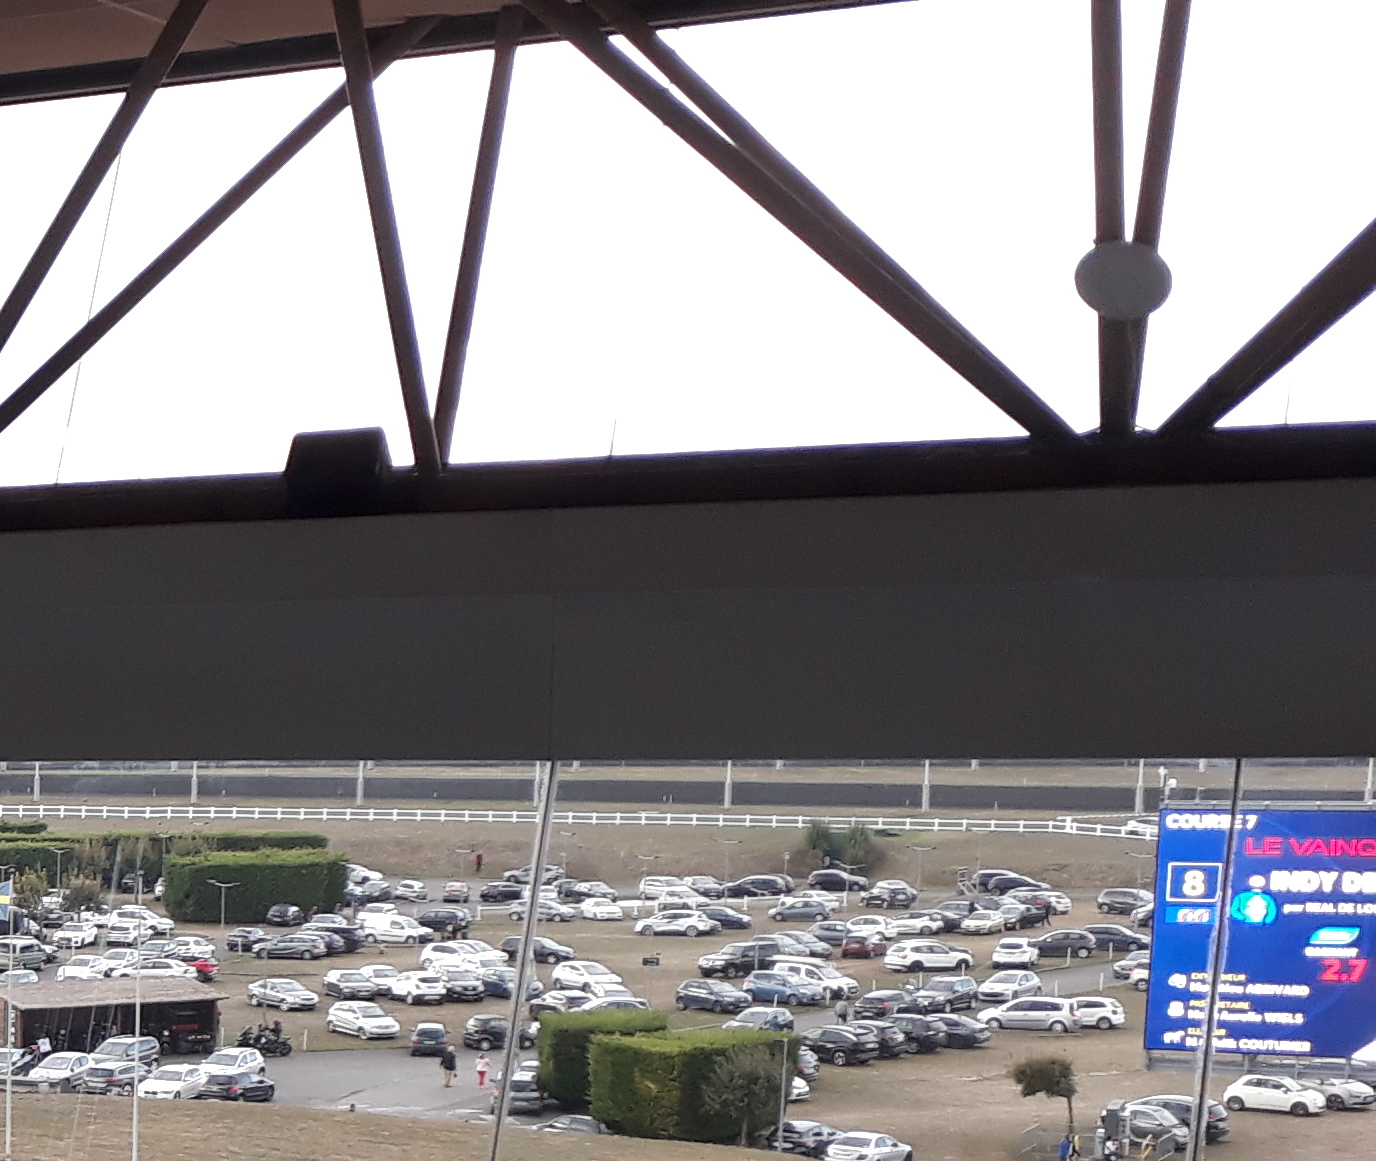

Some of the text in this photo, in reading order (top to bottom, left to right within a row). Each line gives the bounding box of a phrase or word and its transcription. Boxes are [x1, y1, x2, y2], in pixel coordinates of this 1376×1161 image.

[1166, 814, 1257, 830] COURSE 7
[1245, 837, 1376, 857] LE VAINQ
[1182, 869, 1206, 897] 8
[1270, 870, 1339, 892] INDY
[1356, 904, 1376, 914] LO
[1320, 958, 1367, 983] 2.7
